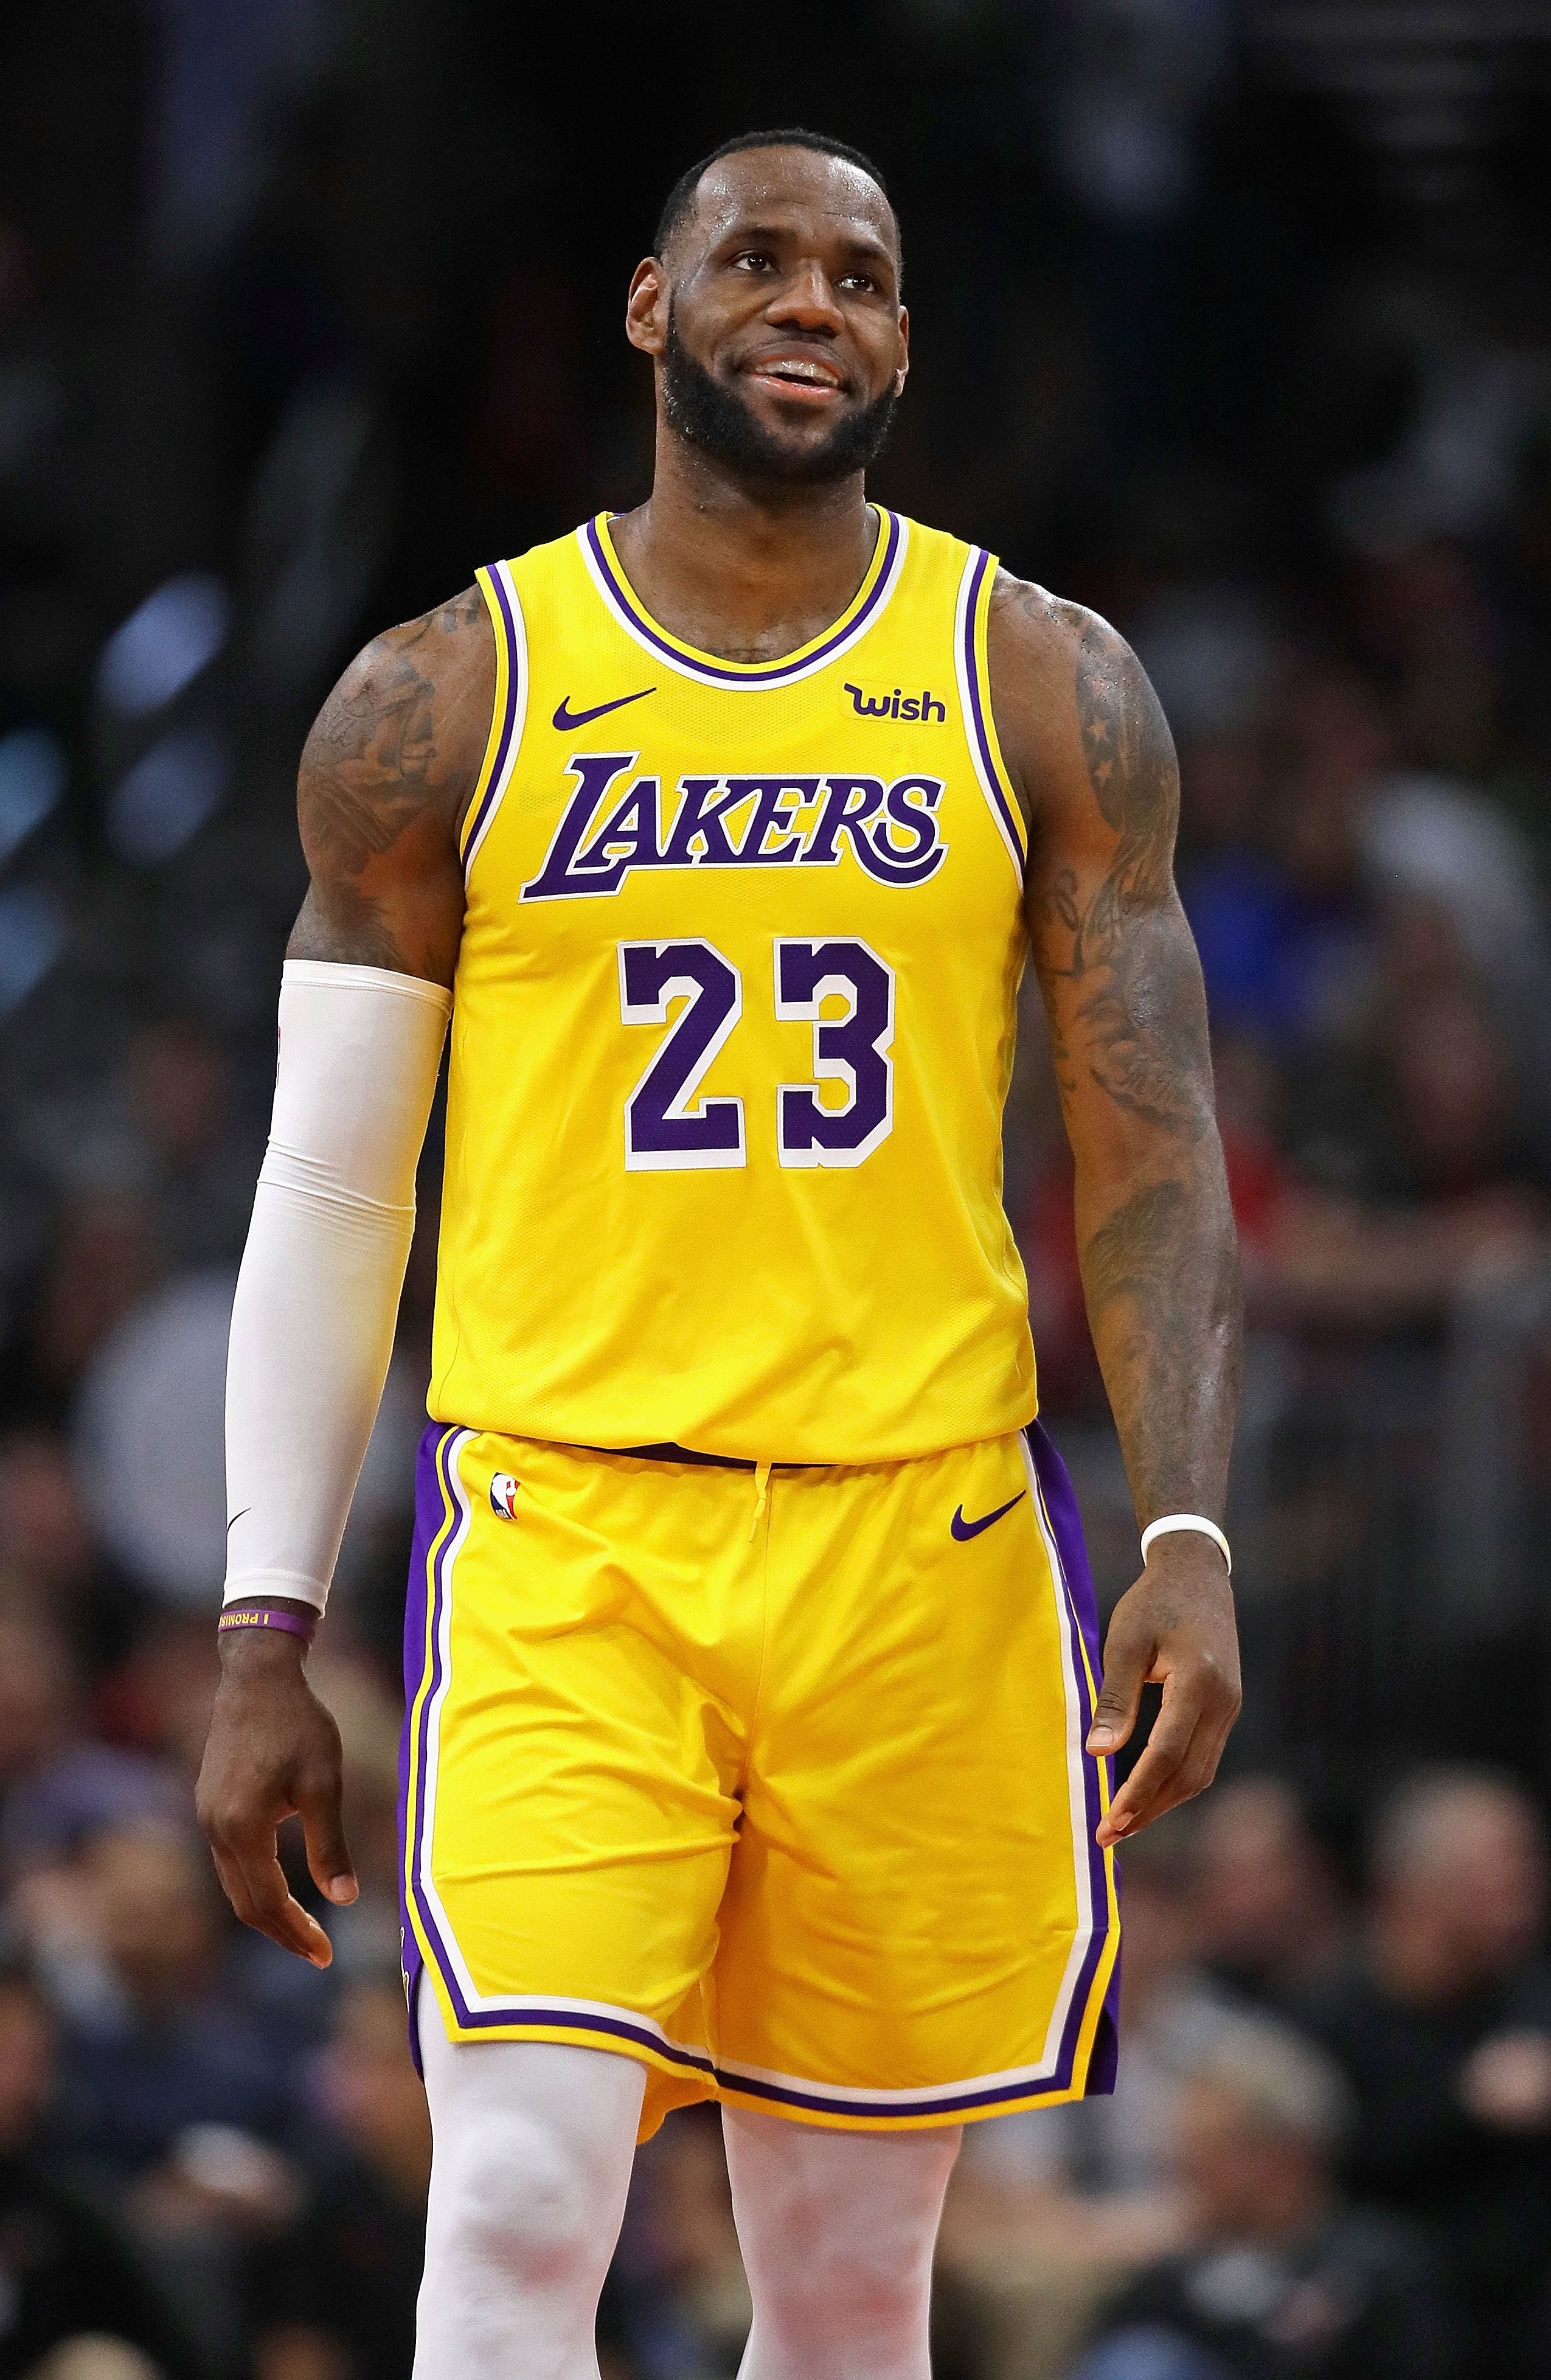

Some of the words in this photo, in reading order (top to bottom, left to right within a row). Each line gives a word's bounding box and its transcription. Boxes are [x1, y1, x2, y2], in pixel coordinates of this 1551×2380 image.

[844, 683, 946, 722] wish
[518, 751, 949, 904] LAKERS
[616, 937, 897, 1171] 23
[263, 1613, 269, 1624] I
